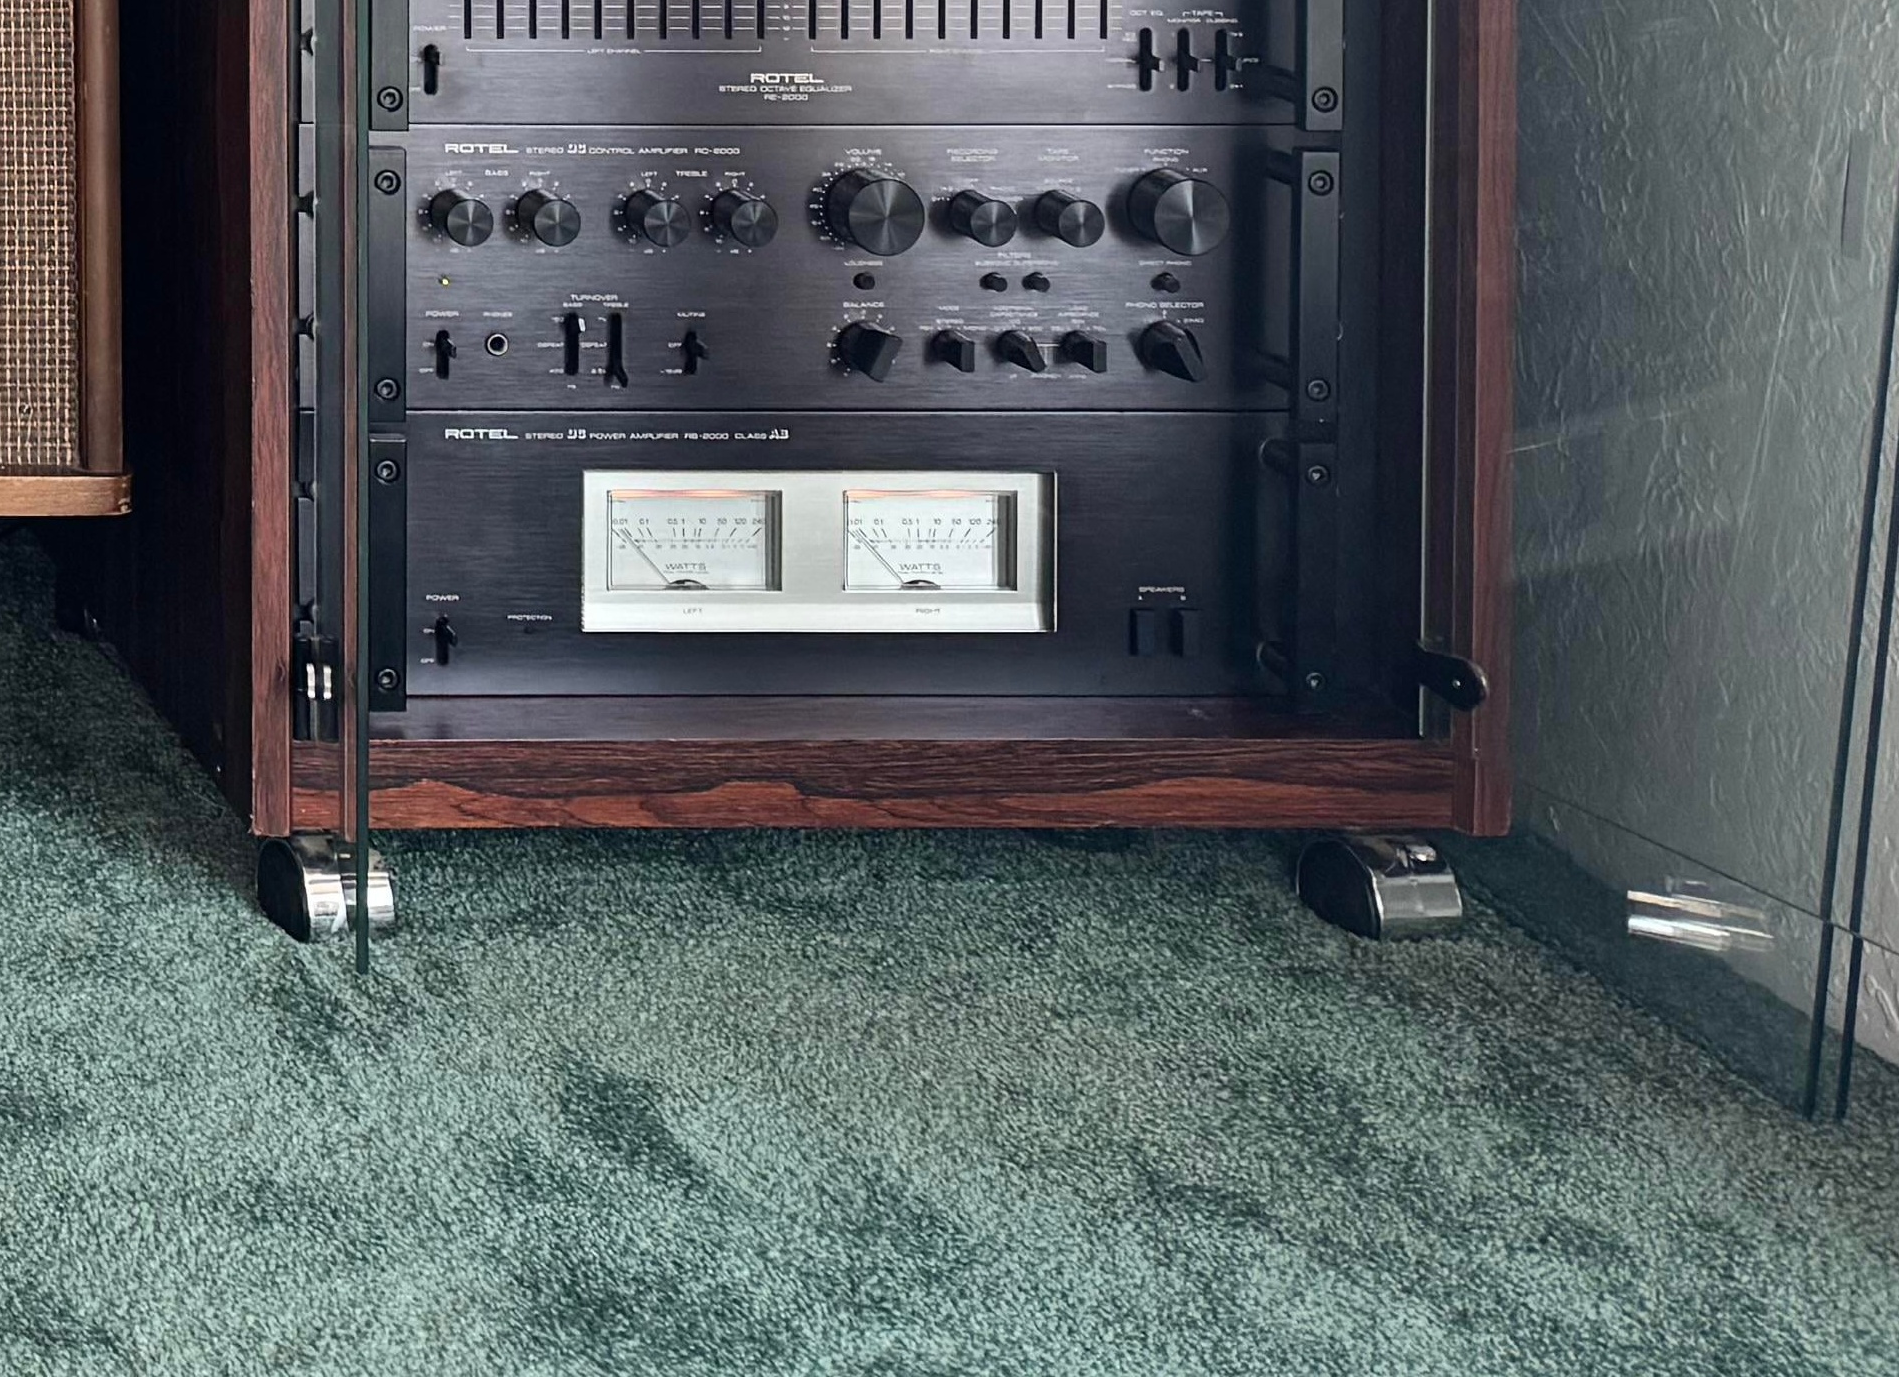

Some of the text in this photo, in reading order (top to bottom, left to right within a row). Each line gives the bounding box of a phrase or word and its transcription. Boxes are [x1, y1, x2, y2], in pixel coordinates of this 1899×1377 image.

[750, 73, 824, 83] ROTEL
[445, 144, 519, 154] ROTEL
[445, 429, 519, 439] ROTEL
